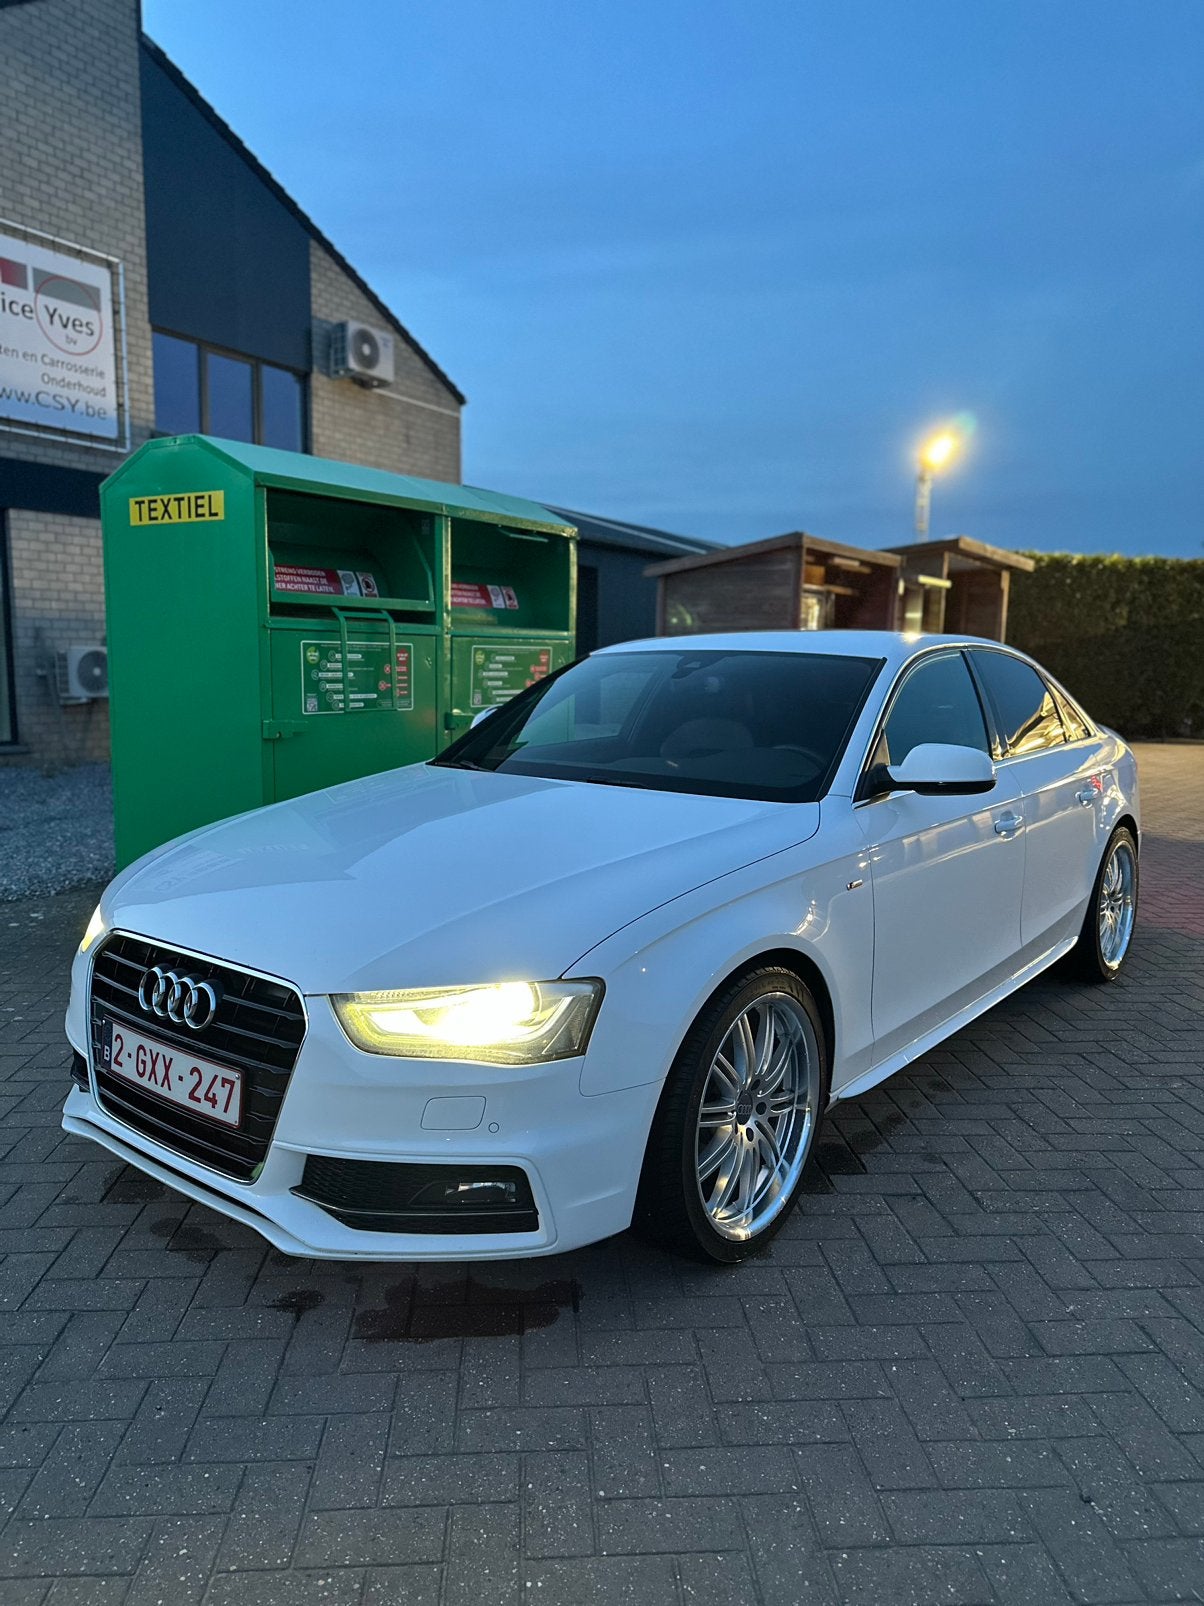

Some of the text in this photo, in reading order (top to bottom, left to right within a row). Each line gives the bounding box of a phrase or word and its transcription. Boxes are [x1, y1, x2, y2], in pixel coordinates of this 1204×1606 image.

[44, 304, 94, 337] Yves
[22, 350, 38, 363] en
[40, 353, 105, 380] Carrosserie
[41, 372, 107, 398] Onderhoud
[134, 494, 219, 522] TEXTIEL
[103, 1045, 110, 1061] B
[113, 1033, 236, 1114] 2-GXX-247
